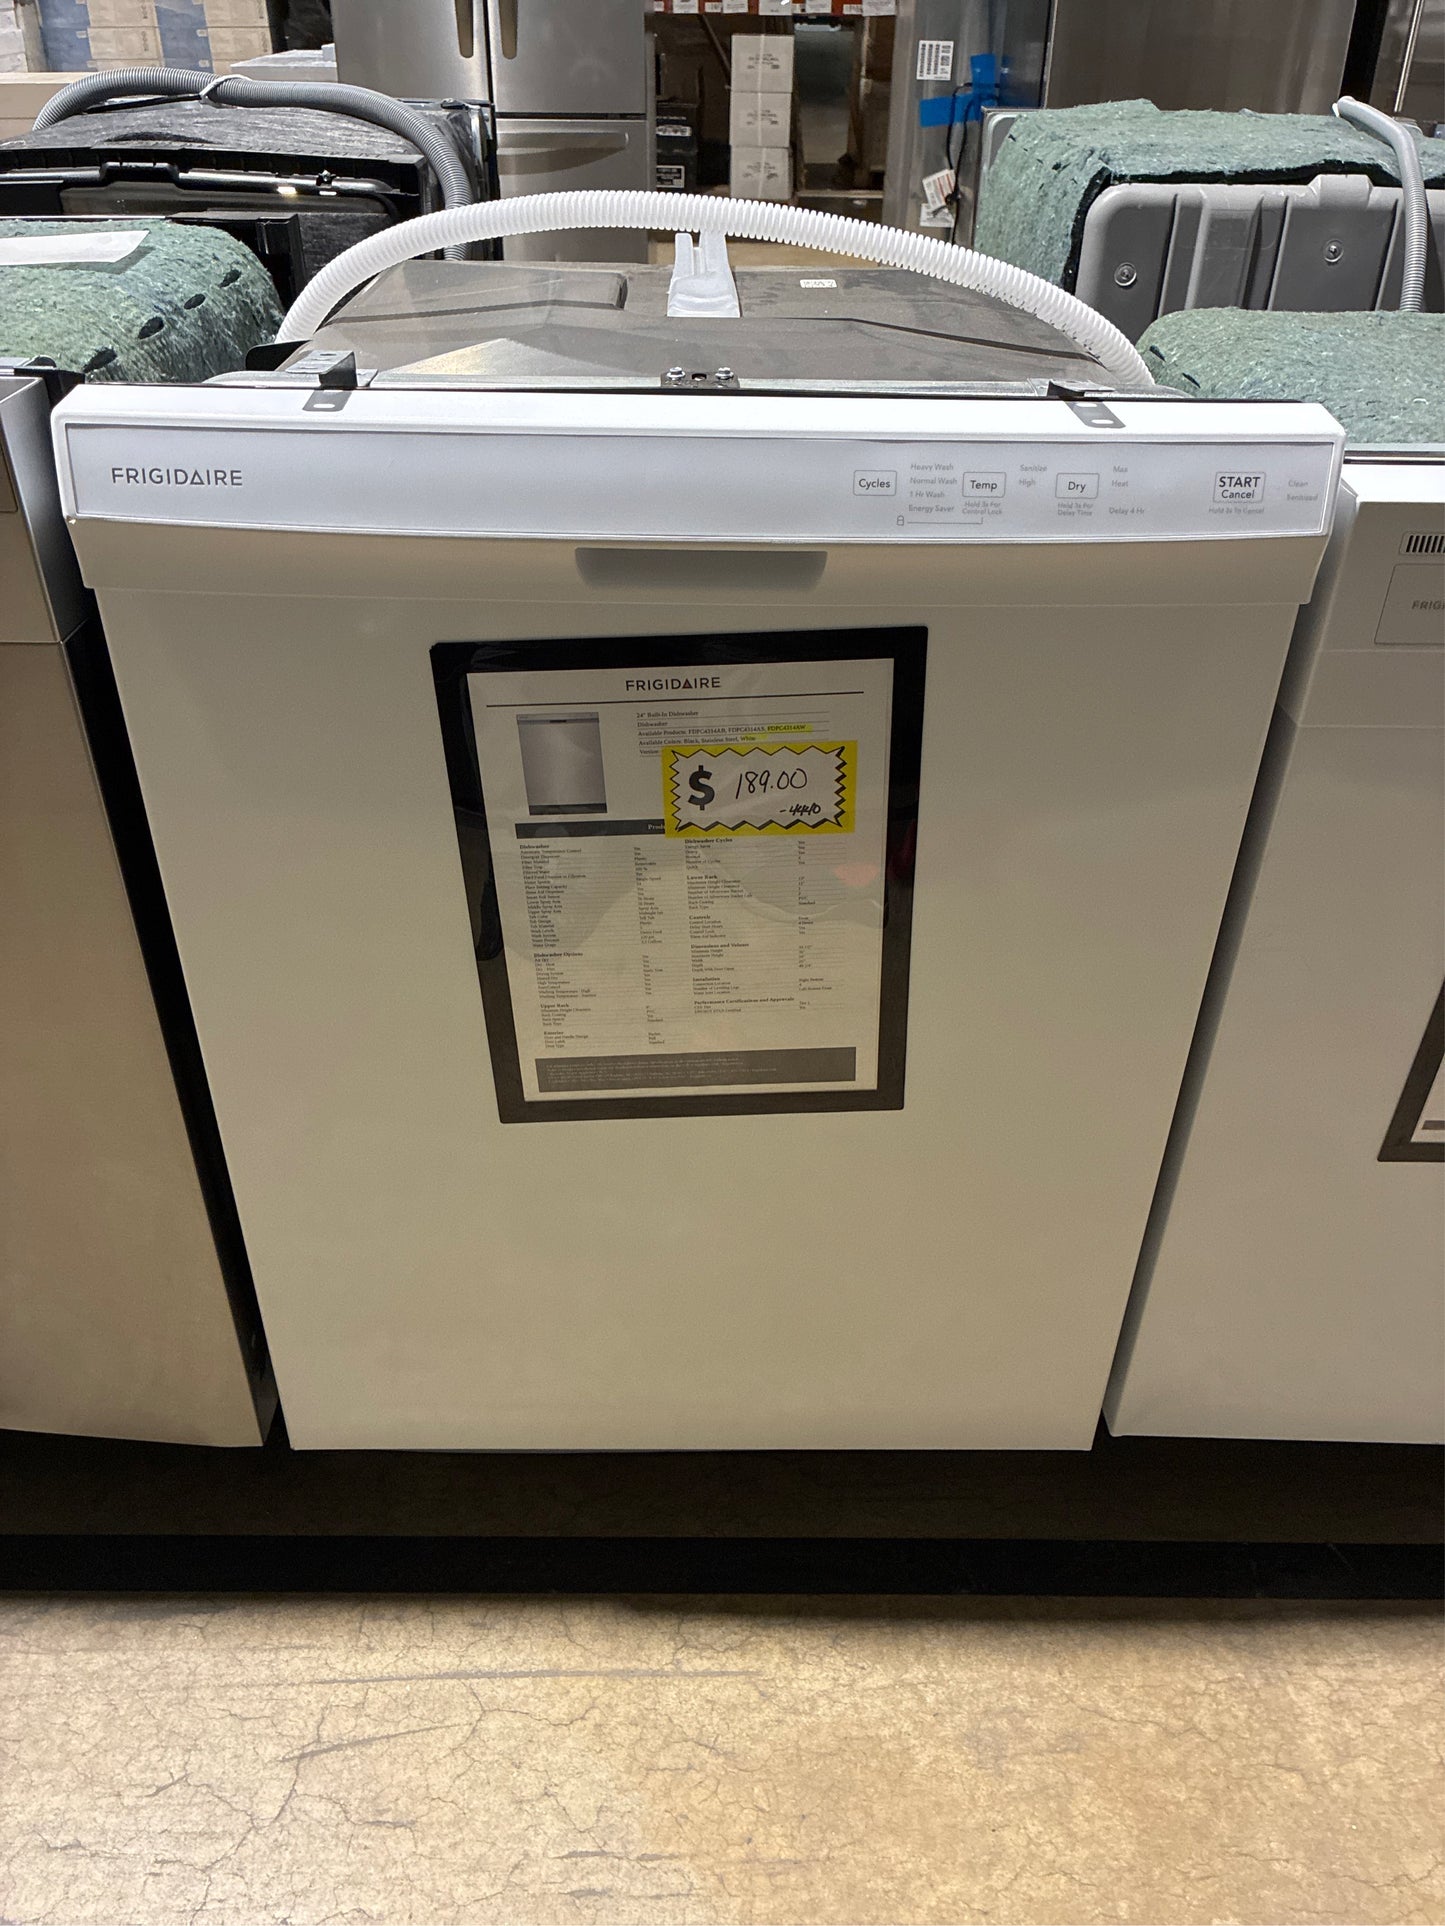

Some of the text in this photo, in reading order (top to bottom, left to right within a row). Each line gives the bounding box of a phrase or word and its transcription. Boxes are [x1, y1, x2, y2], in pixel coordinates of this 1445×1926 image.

[910, 463, 932, 472] Heavy
[111, 467, 243, 486] FRIGIDAIRE
[909, 477, 931, 485] Normal
[1219, 476, 1261, 488] START
[858, 478, 890, 490] Cycles
[970, 480, 998, 492] Temp
[1019, 479, 1036, 488] High
[1067, 481, 1086, 494] Dry
[925, 490, 945, 498] Wash
[1221, 489, 1255, 499] Cancel
[908, 504, 955, 514] Energy Saver
[625, 676, 721, 691] FRIGIDAIRE
[688, 764, 808, 810] $ 189.00
